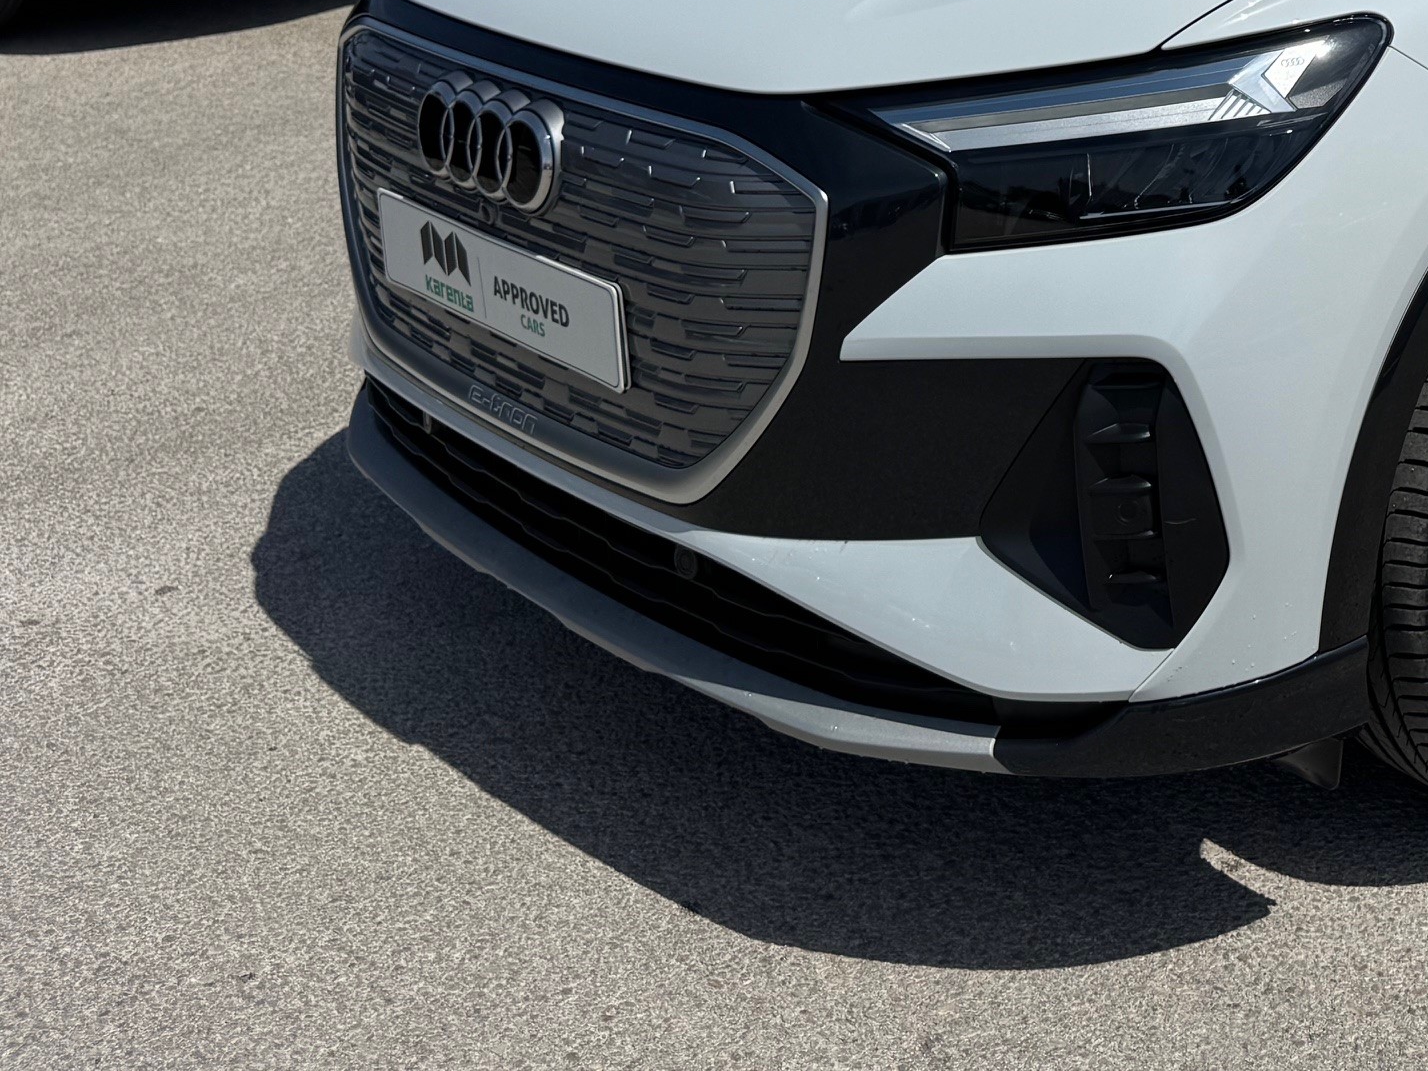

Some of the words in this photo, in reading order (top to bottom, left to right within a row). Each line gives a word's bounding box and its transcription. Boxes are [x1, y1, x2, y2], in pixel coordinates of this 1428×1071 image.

[425, 274, 475, 313] karenta
[493, 275, 570, 327] APPROVED
[520, 314, 546, 337] CARS
[469, 384, 538, 435] e-tron
